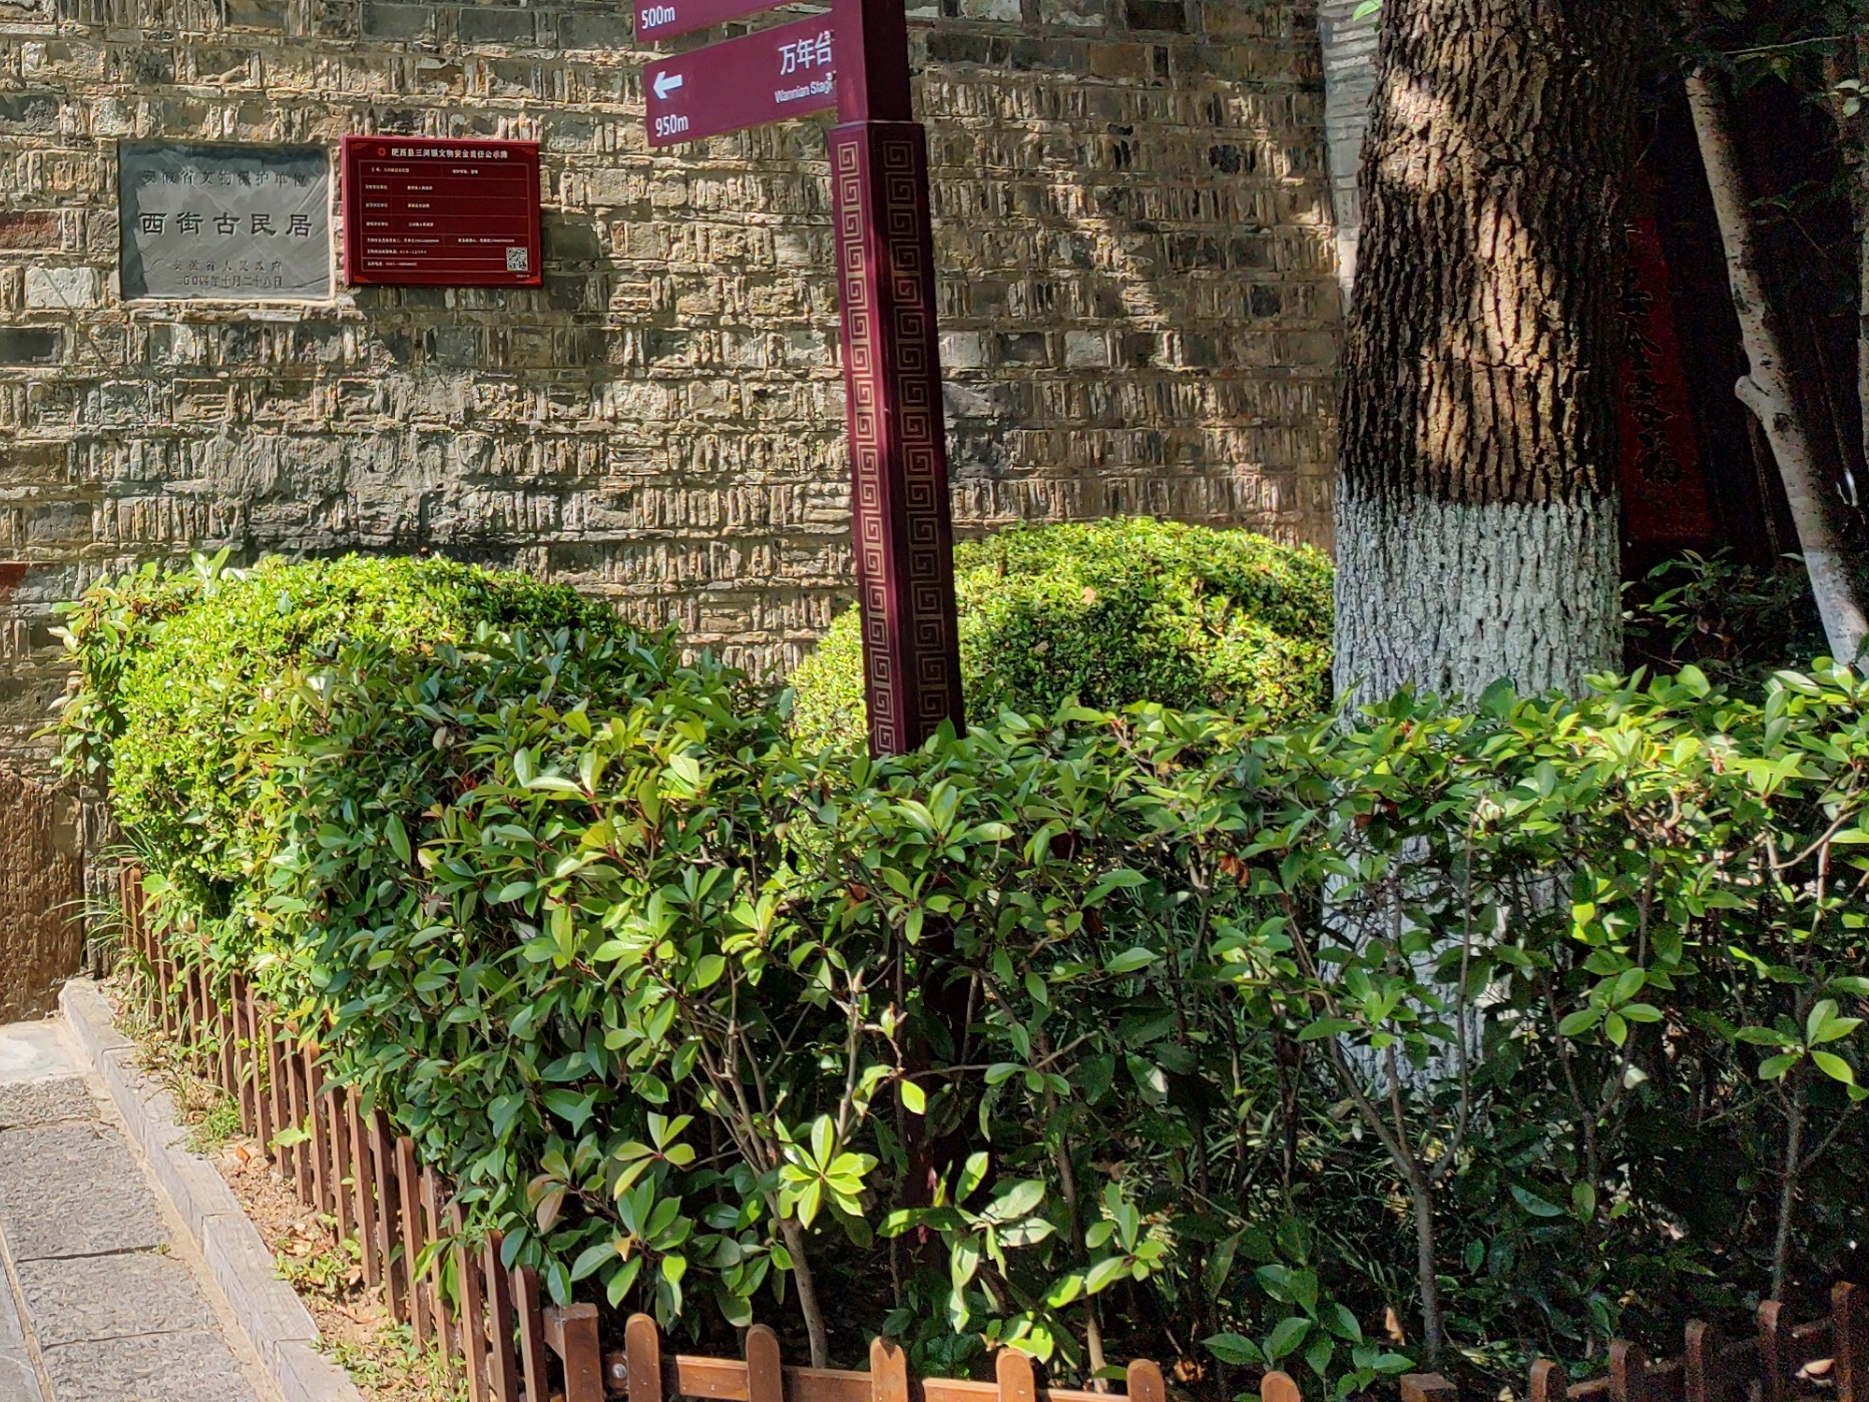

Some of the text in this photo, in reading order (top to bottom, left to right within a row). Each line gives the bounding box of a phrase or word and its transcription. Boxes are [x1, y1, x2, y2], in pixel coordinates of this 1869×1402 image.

[641, 6, 676, 29] 500m
[778, 31, 832, 75] 万年台
[655, 114, 689, 137] 950m
[139, 211, 313, 238] 西街古民居
